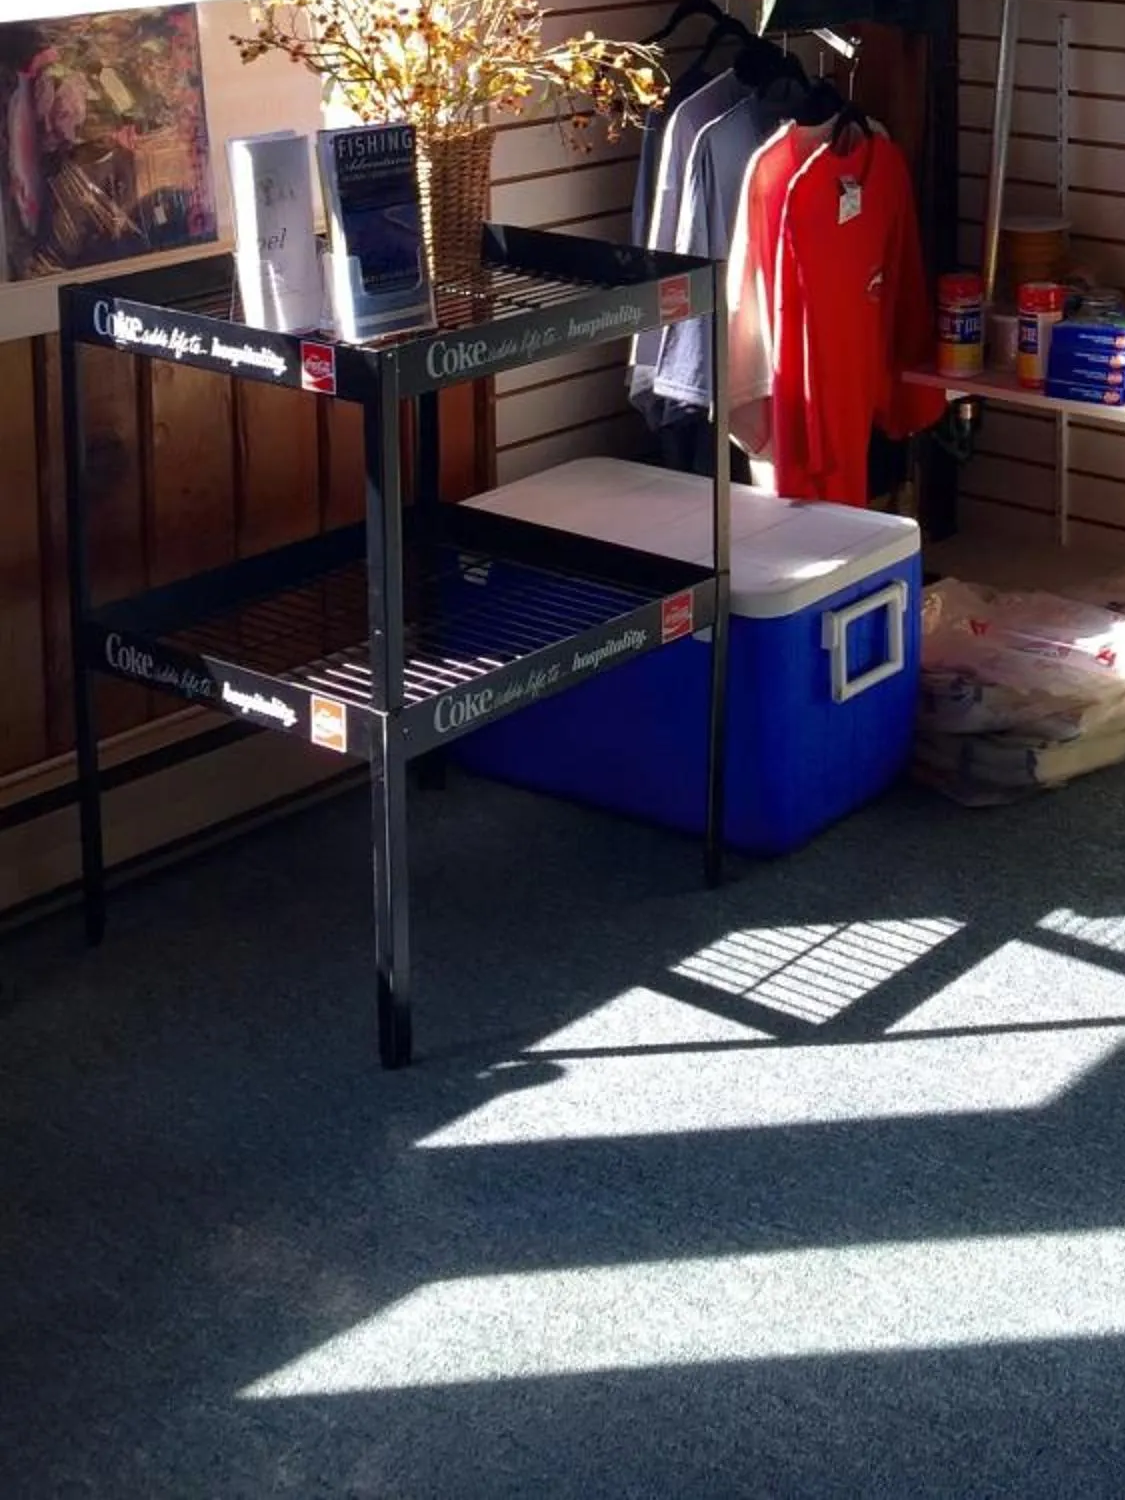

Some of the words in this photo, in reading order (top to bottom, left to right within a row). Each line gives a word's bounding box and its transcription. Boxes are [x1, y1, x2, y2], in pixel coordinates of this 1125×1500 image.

[338, 130, 413, 158] FISHING
[93, 300, 144, 344] Coke
[426, 339, 487, 379] Coke
[104, 632, 154, 678] Coke
[433, 687, 493, 734] Coke
